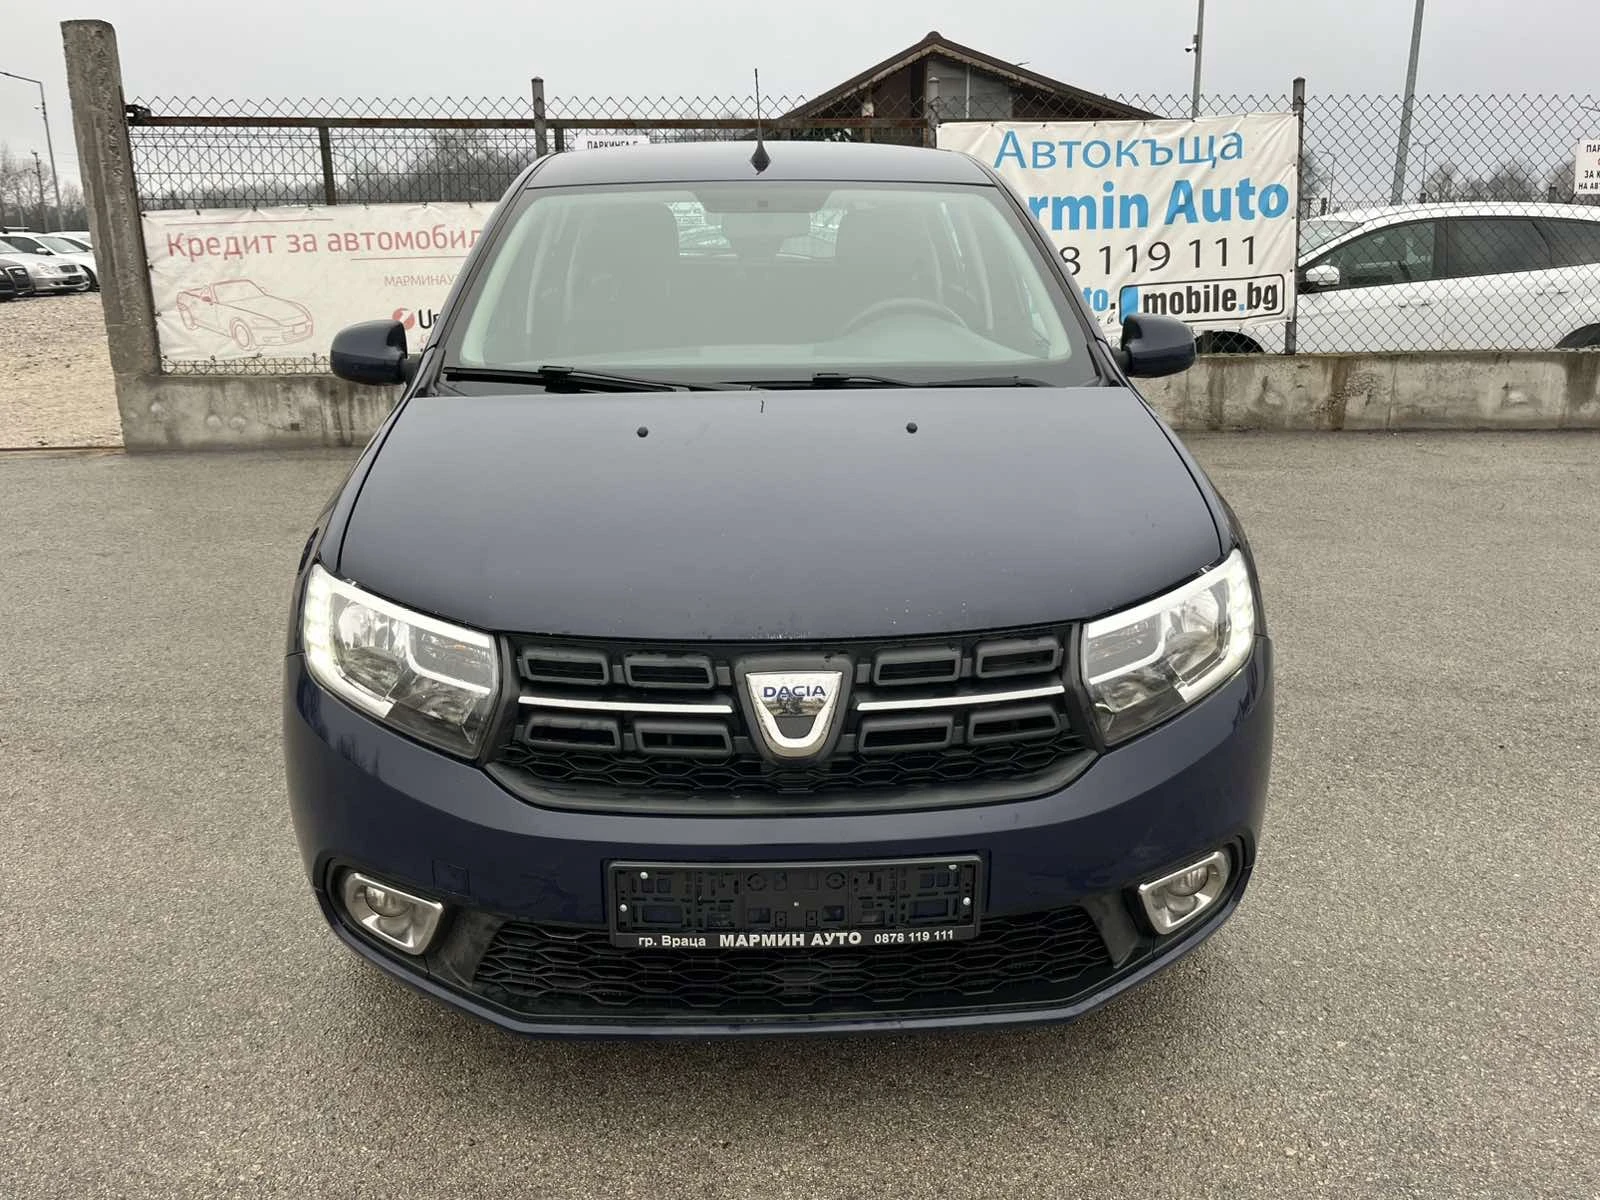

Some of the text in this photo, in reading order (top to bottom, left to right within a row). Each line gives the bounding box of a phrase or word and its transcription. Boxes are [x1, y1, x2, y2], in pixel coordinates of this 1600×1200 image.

[993, 130, 1243, 168] Автокъща
[1164, 177, 1289, 225] Auto
[166, 232, 276, 262] Кредит
[287, 232, 318, 253] за
[1099, 241, 1171, 275] 119
[1188, 236, 1255, 268] 111
[1143, 282, 1278, 315] mobile.bg
[763, 685, 826, 698] DACIA
[638, 929, 953, 947] гр. Враца МАРМИН АУТО 0878 119 111
